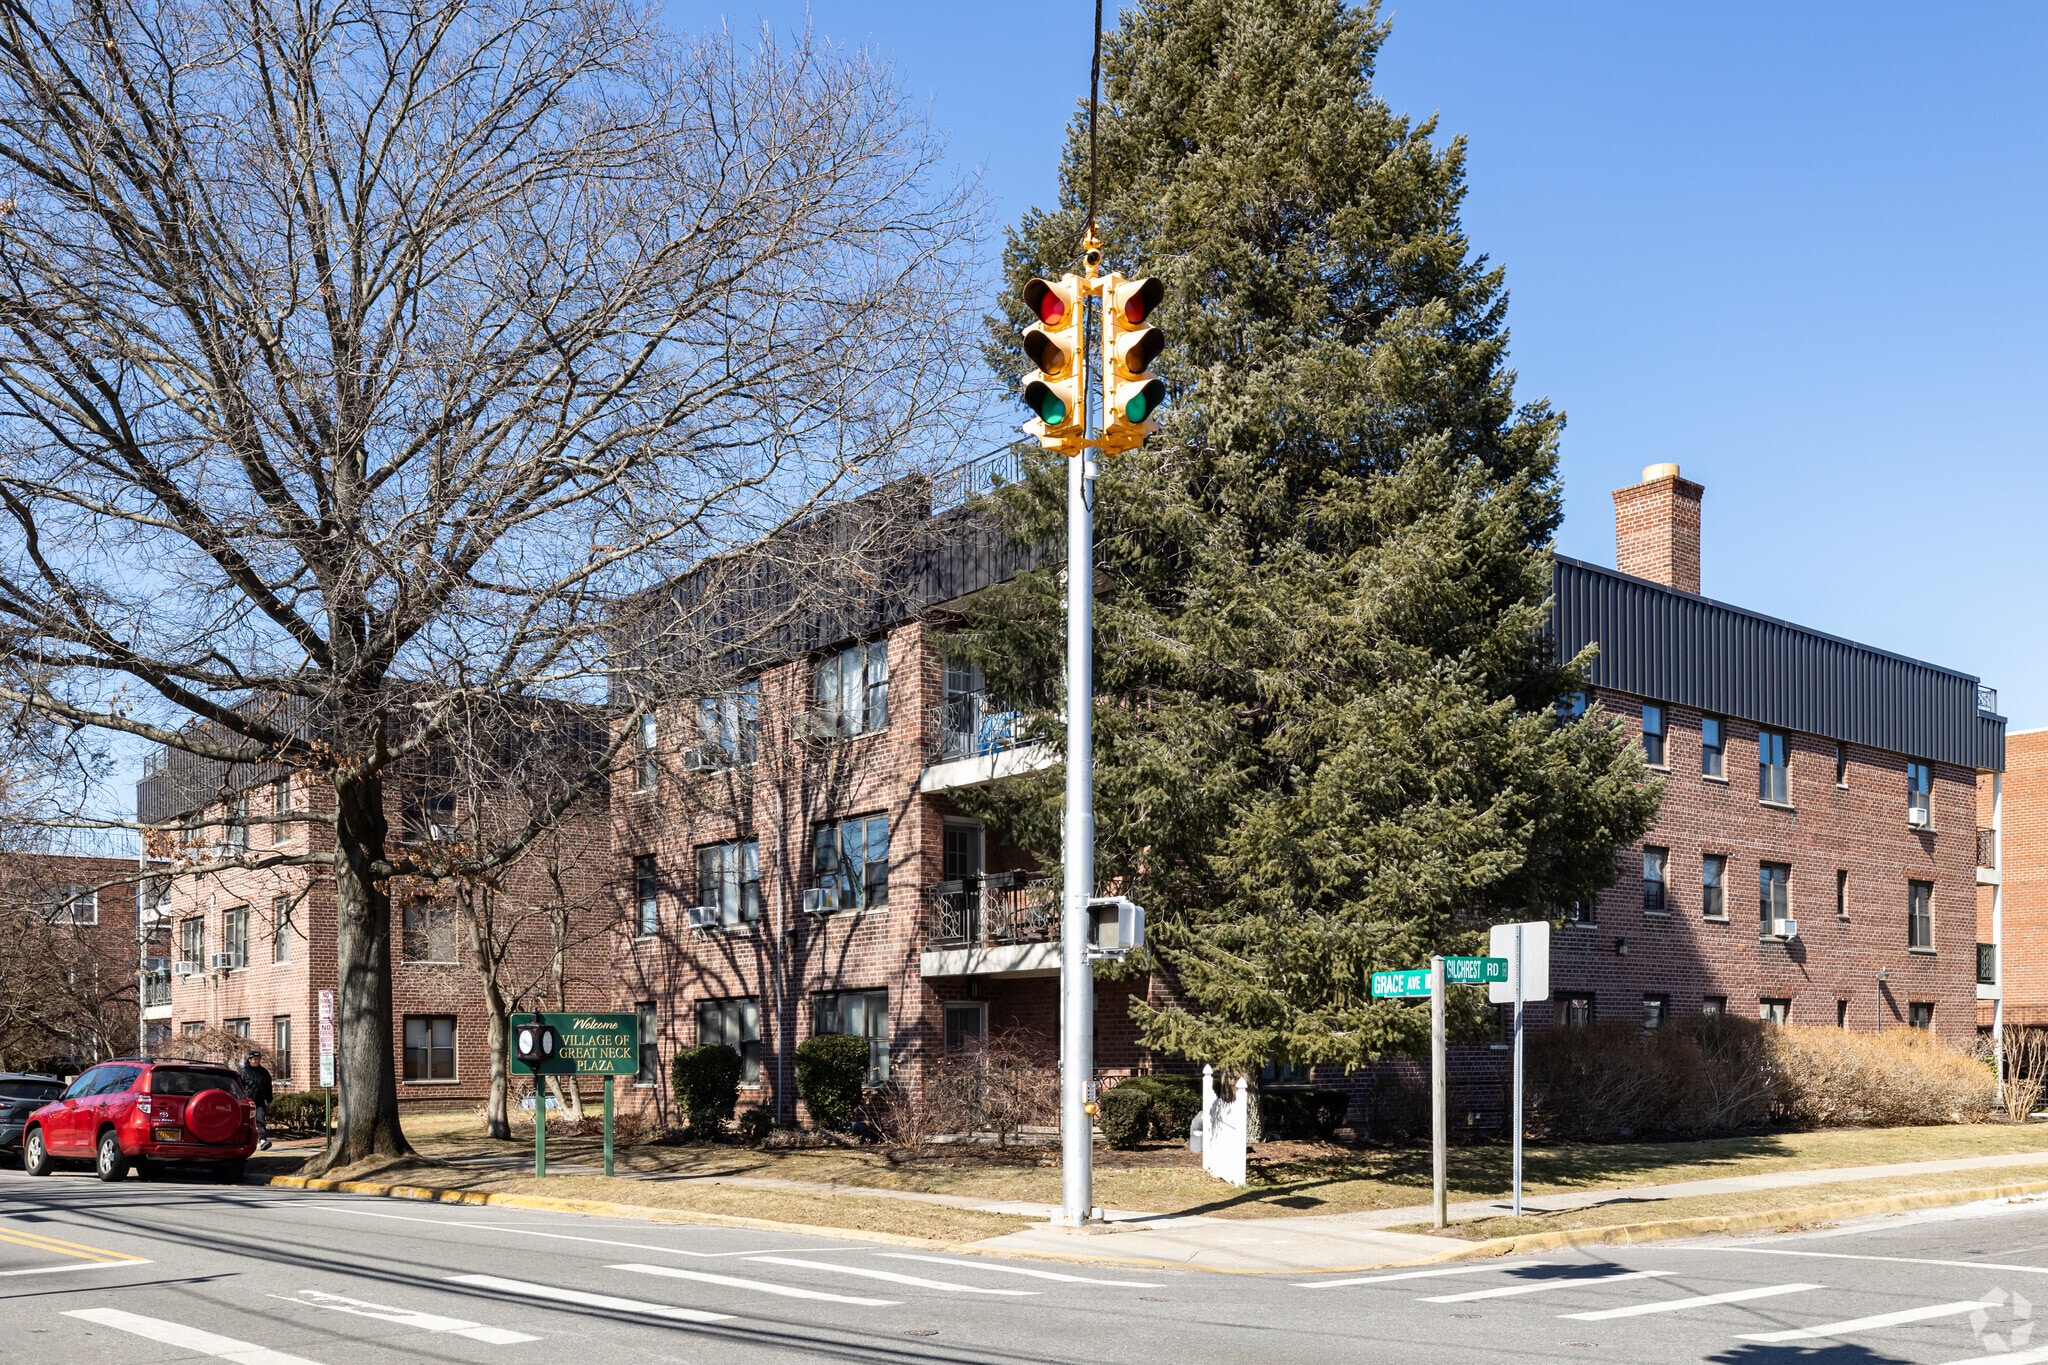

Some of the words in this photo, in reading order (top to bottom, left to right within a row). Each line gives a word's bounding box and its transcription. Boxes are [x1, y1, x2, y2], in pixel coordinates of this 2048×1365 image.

[1446, 960, 1481, 978] GILCHREST
[1487, 962, 1499, 976] RD
[1374, 974, 1404, 994] GRACE
[1407, 976, 1421, 990] AVE
[573, 1017, 619, 1030] Welcome
[561, 1034, 612, 1046] VILLAGE
[614, 1034, 630, 1046] OF
[558, 1047, 598, 1059] GREAT
[600, 1047, 631, 1059] NECK
[577, 1060, 615, 1071] PLAZA
